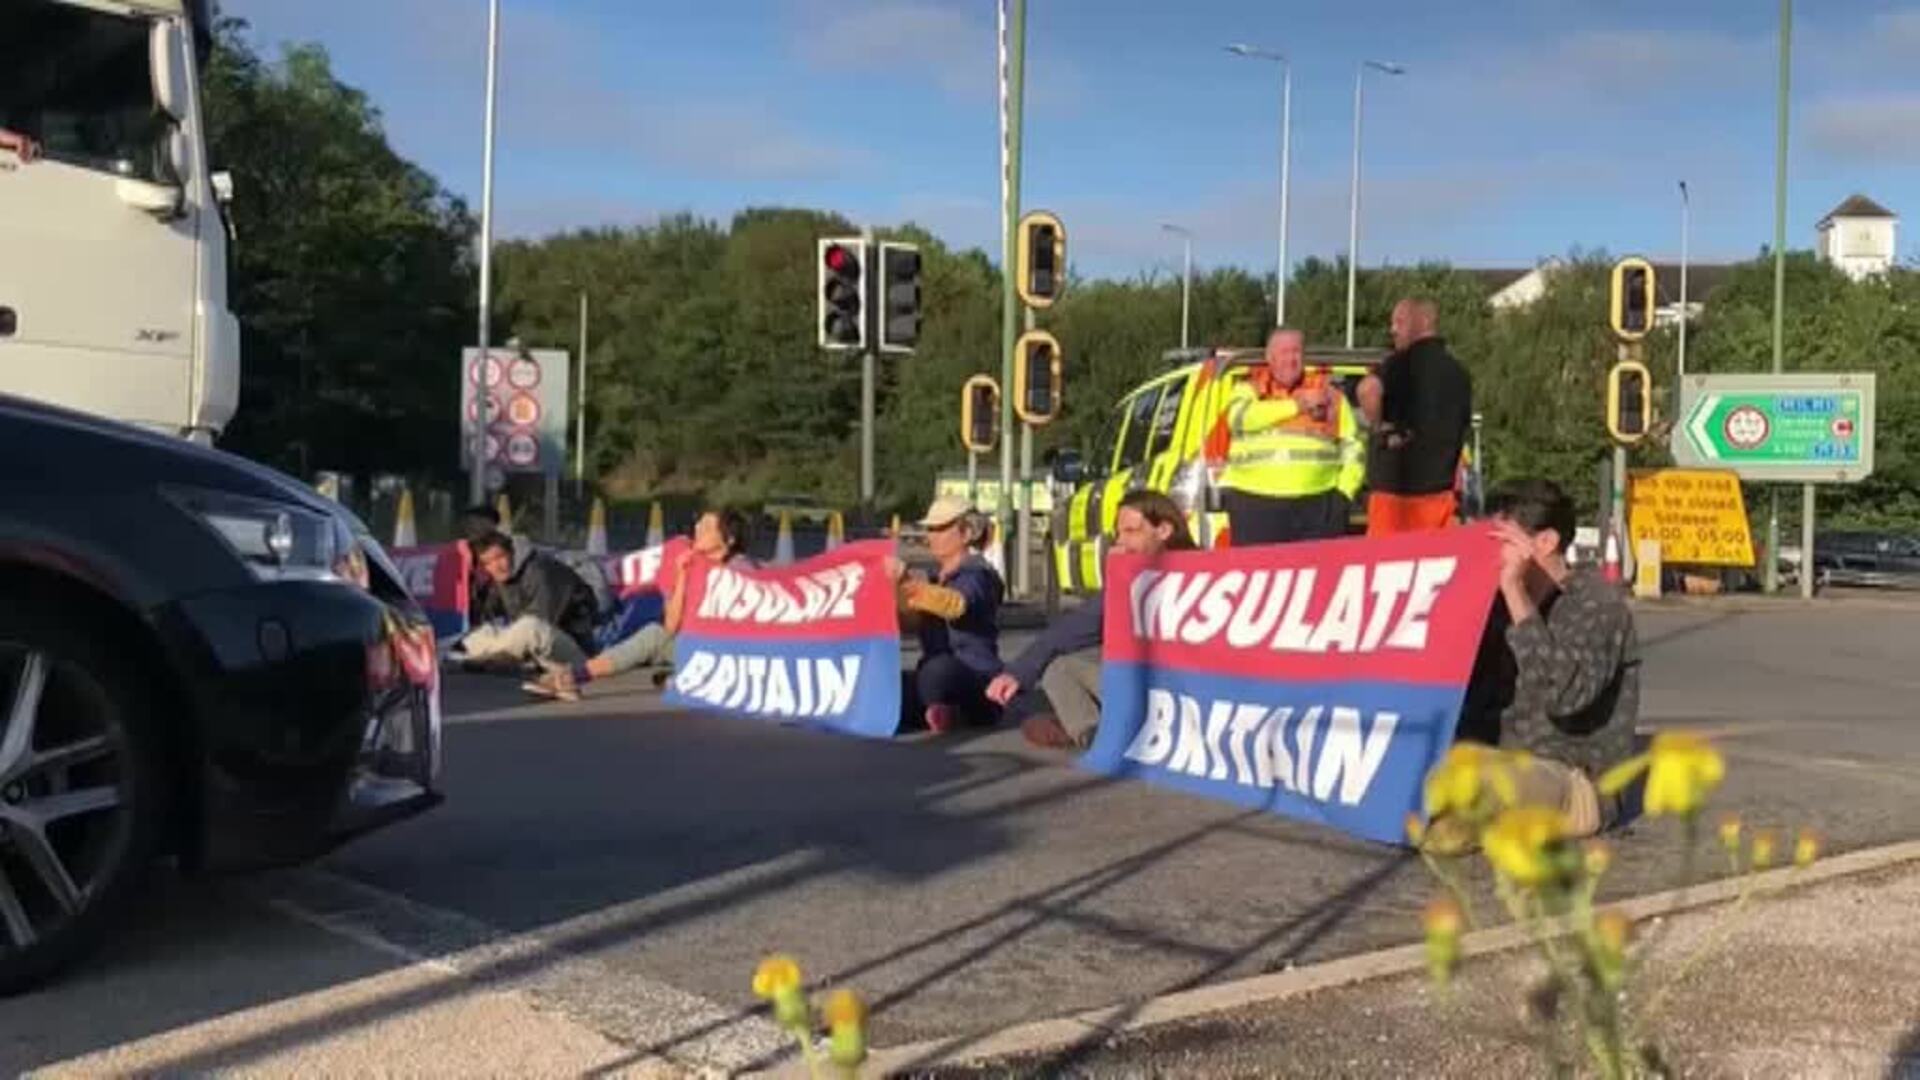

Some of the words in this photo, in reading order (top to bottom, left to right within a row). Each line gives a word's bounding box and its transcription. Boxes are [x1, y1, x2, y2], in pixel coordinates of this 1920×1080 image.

[697, 561, 864, 623] INSULATE
[1130, 557, 1457, 652] INSULATE
[675, 651, 861, 716] BRITAIN
[1124, 689, 1399, 805] BRITAIN
